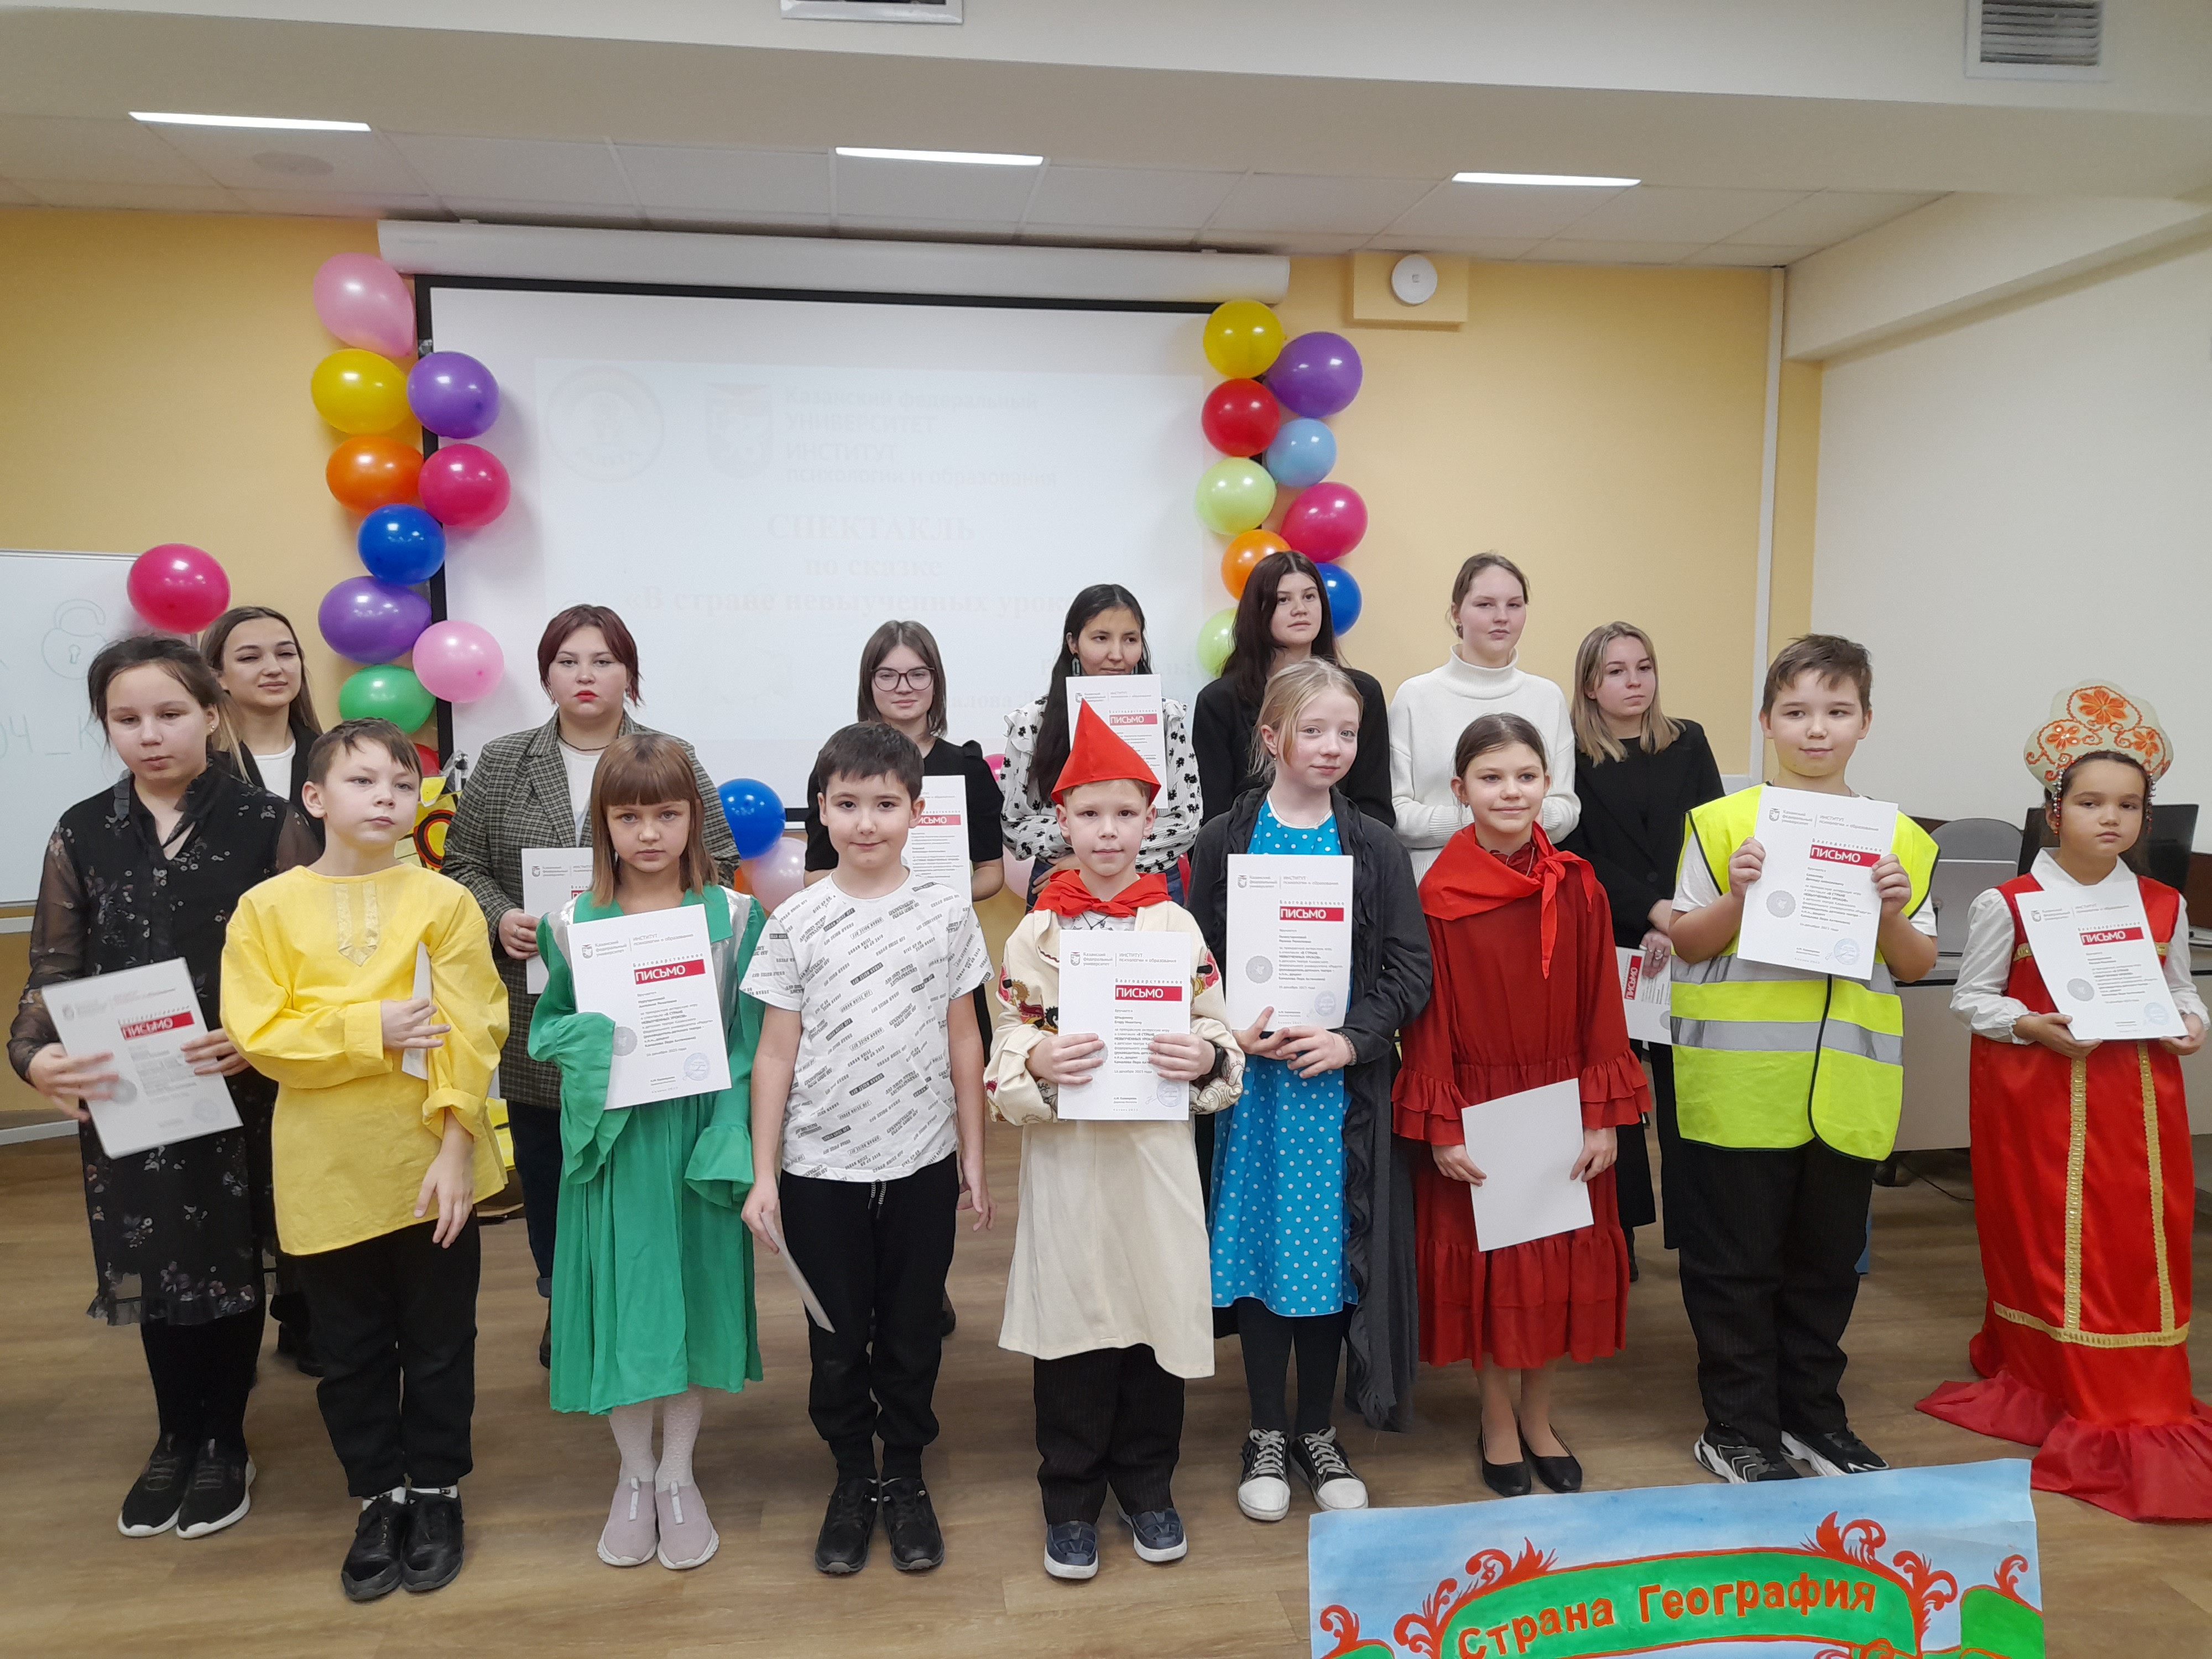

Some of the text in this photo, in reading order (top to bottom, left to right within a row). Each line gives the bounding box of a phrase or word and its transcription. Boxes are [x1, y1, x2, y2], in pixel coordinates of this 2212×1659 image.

[784, 387, 1039, 413] Казанский федеральный
[784, 413, 937, 434] УНИВЕРСИТЕТ
[785, 442, 896, 462] ИНСТИТУТ
[786, 468, 1058, 489] психологии и образования
[767, 512, 977, 541] СПЕКТАКЛЬ
[805, 557, 943, 577] по сказке
[785, 592, 988, 617] невыученных
[1812, 838, 1882, 852] Благодарственное
[1811, 847, 1861, 863] ПИСЬМО
[1281, 908, 1327, 919] ПИСЬМО
[870, 918, 882, 927] URBAN
[861, 938, 870, 946] NOISE
[2081, 931, 2126, 943] ПИСЬМО
[633, 953, 703, 967] Благодарственное
[635, 964, 686, 982] ПИСЬМО
[870, 963, 882, 973] URBAN
[1116, 988, 1164, 999] ПИСЬМО
[841, 1003, 852, 1013] URBAN
[853, 995, 863, 1004] NOISE
[858, 1035, 870, 1045] NOISE
[870, 1027, 883, 1038] URBAN
[848, 1057, 860, 1067] URBAN
[1638, 1572, 1878, 1623] География
